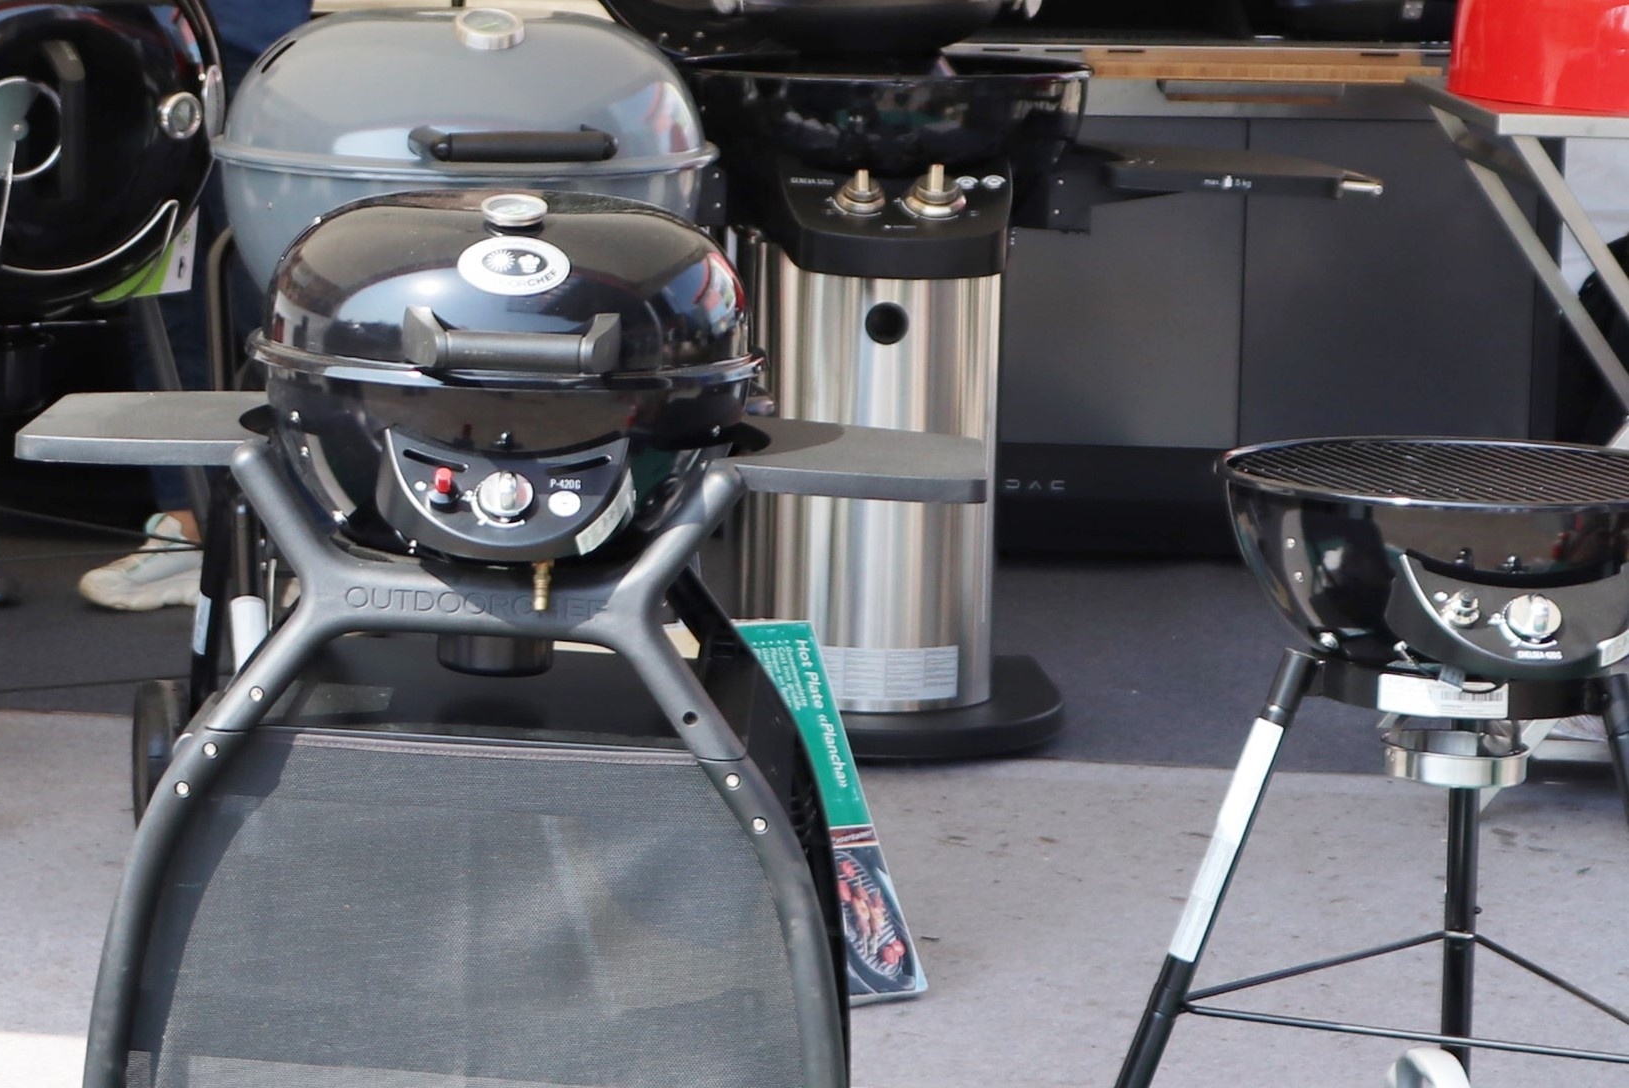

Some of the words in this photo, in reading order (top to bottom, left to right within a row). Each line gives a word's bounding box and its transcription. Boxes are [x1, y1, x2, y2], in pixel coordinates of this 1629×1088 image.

[549, 478, 582, 490] P-420G
[795, 639, 813, 668] Hot
[804, 671, 824, 709] Plate
[818, 714, 848, 788] «Plancha»
